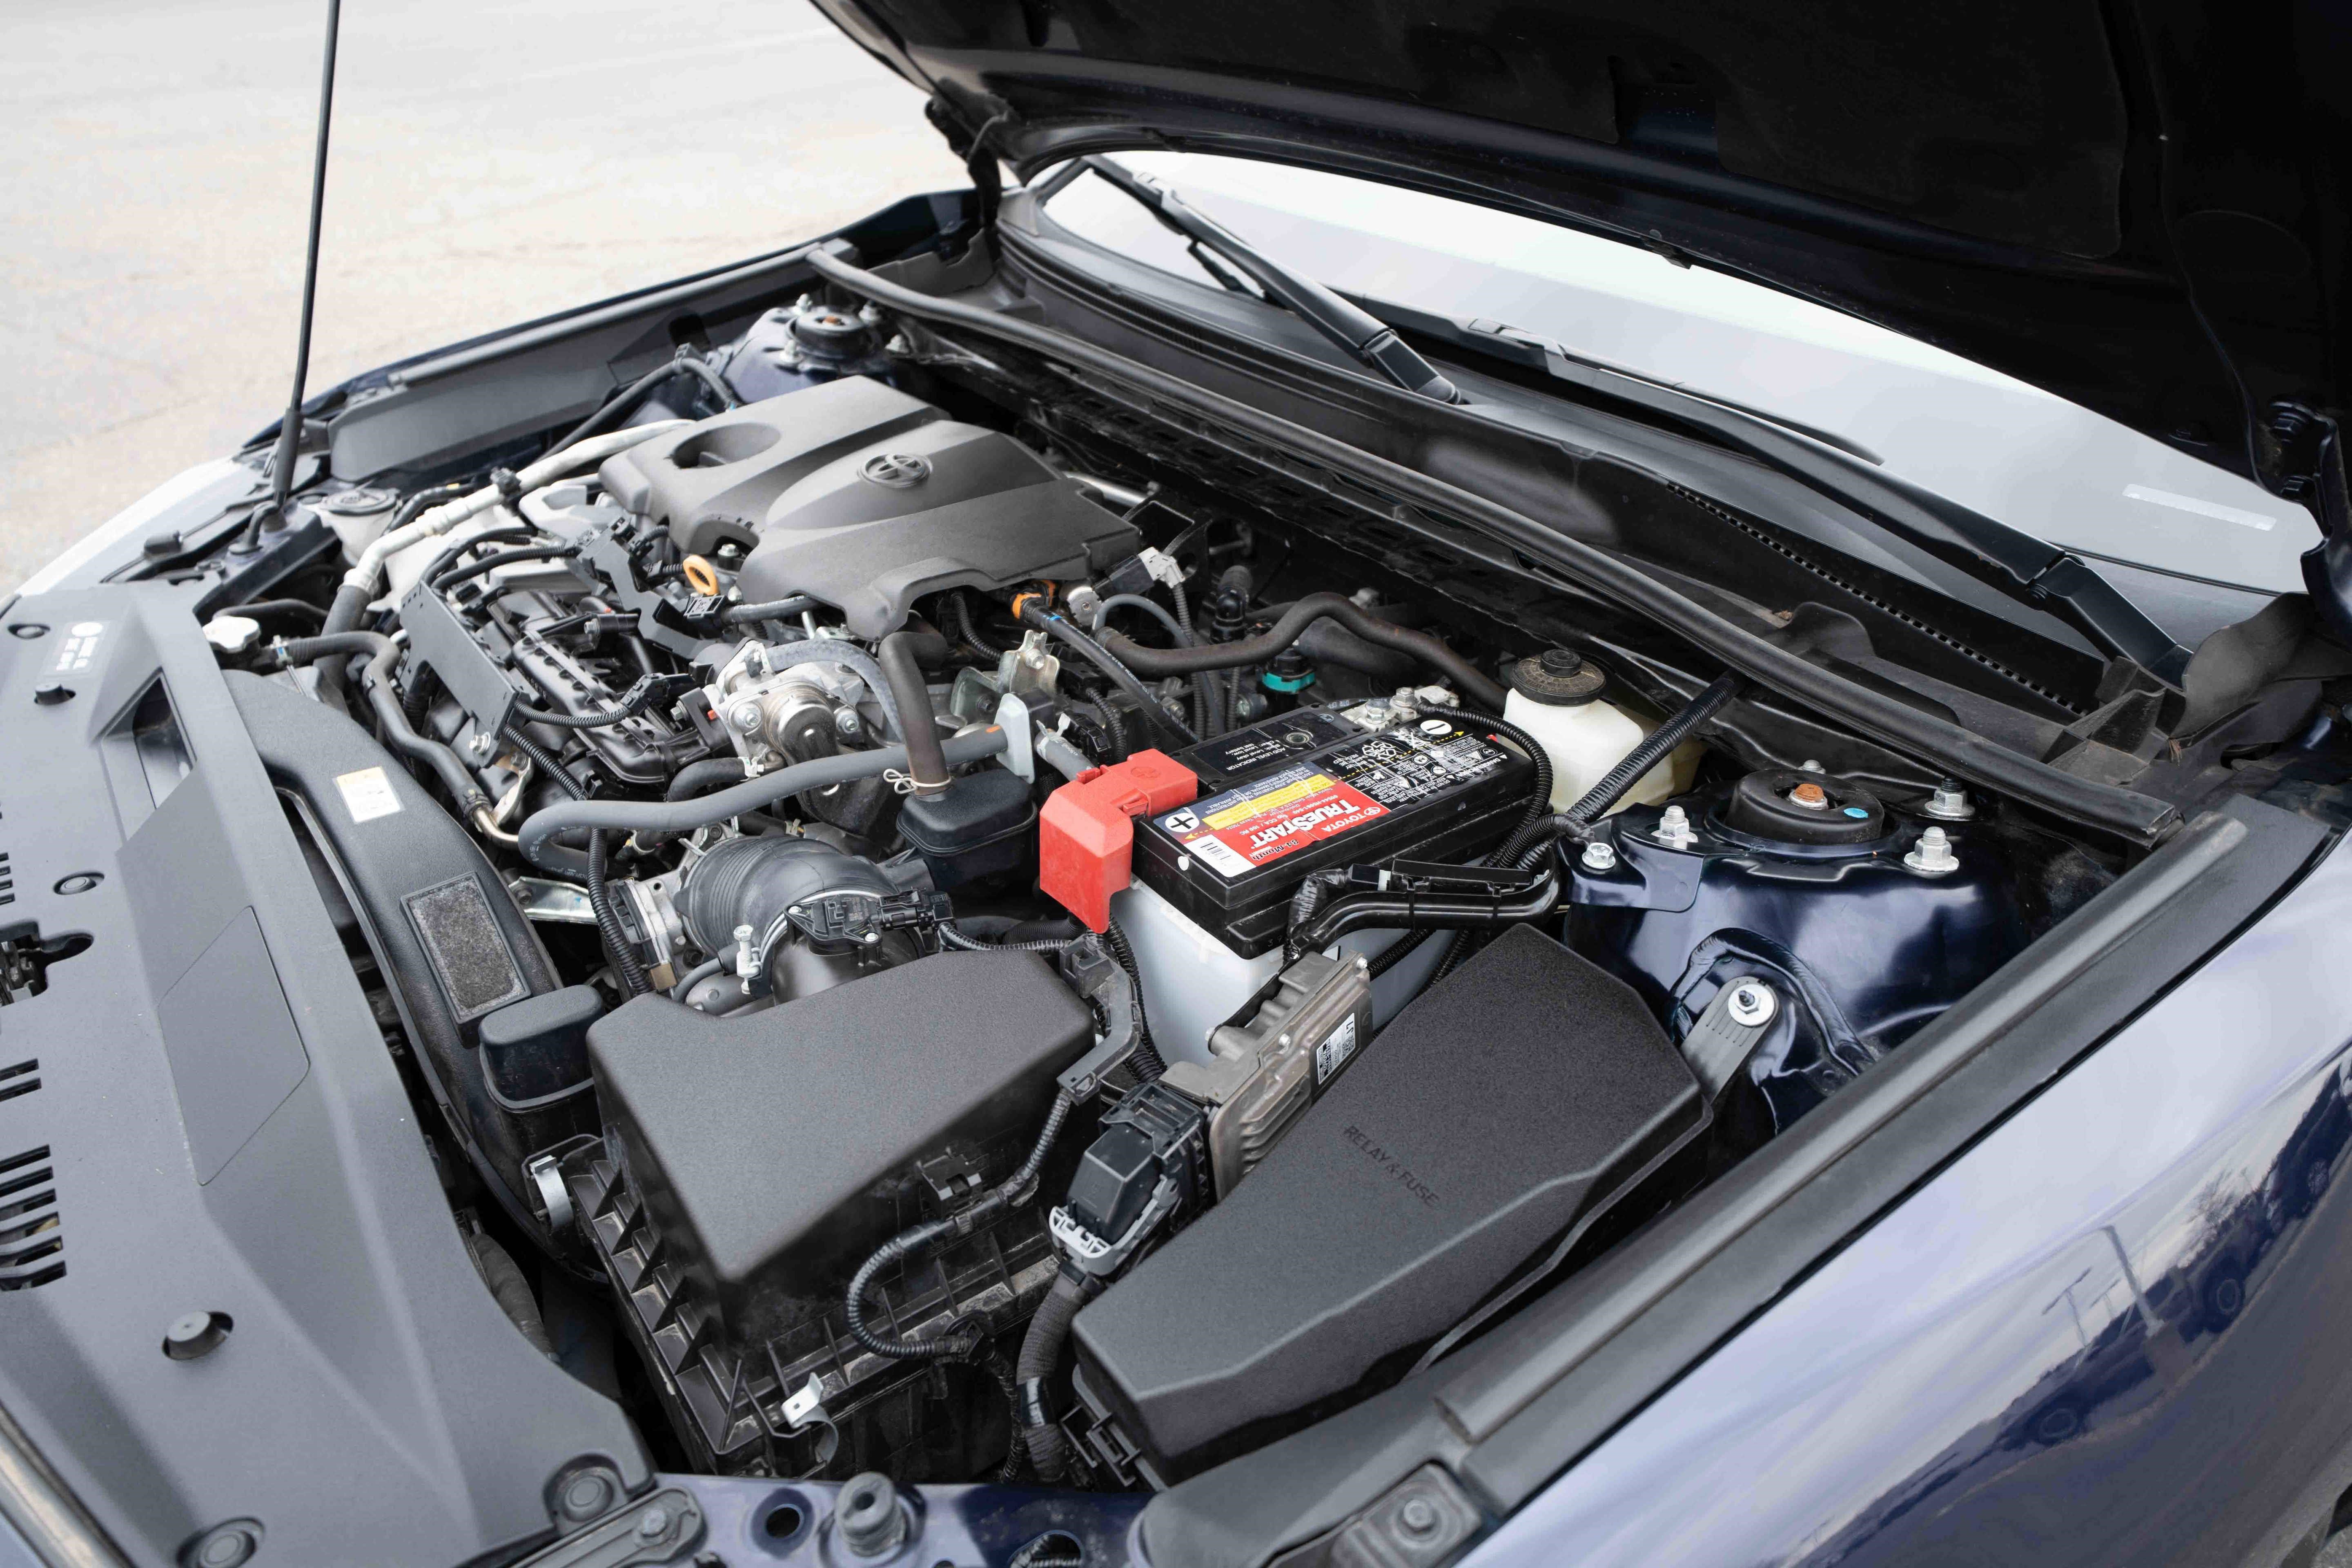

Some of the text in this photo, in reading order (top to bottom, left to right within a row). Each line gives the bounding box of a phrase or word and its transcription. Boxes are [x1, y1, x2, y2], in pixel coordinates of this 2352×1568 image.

[1223, 746, 1245, 755] battery
[1254, 751, 1274, 760] LEVEL
[1225, 757, 1258, 771] INDICATOR
[1276, 770, 1296, 779] SEVICE
[1250, 784, 1271, 793] MANUAL
[1203, 799, 1240, 815] INSTRUCTIONS
[1319, 811, 1367, 833] TOYOTA
[1250, 838, 1302, 862] 84-Month
[1343, 1125, 1391, 1163] RELAY
[1398, 1171, 1441, 1207] FUSE
